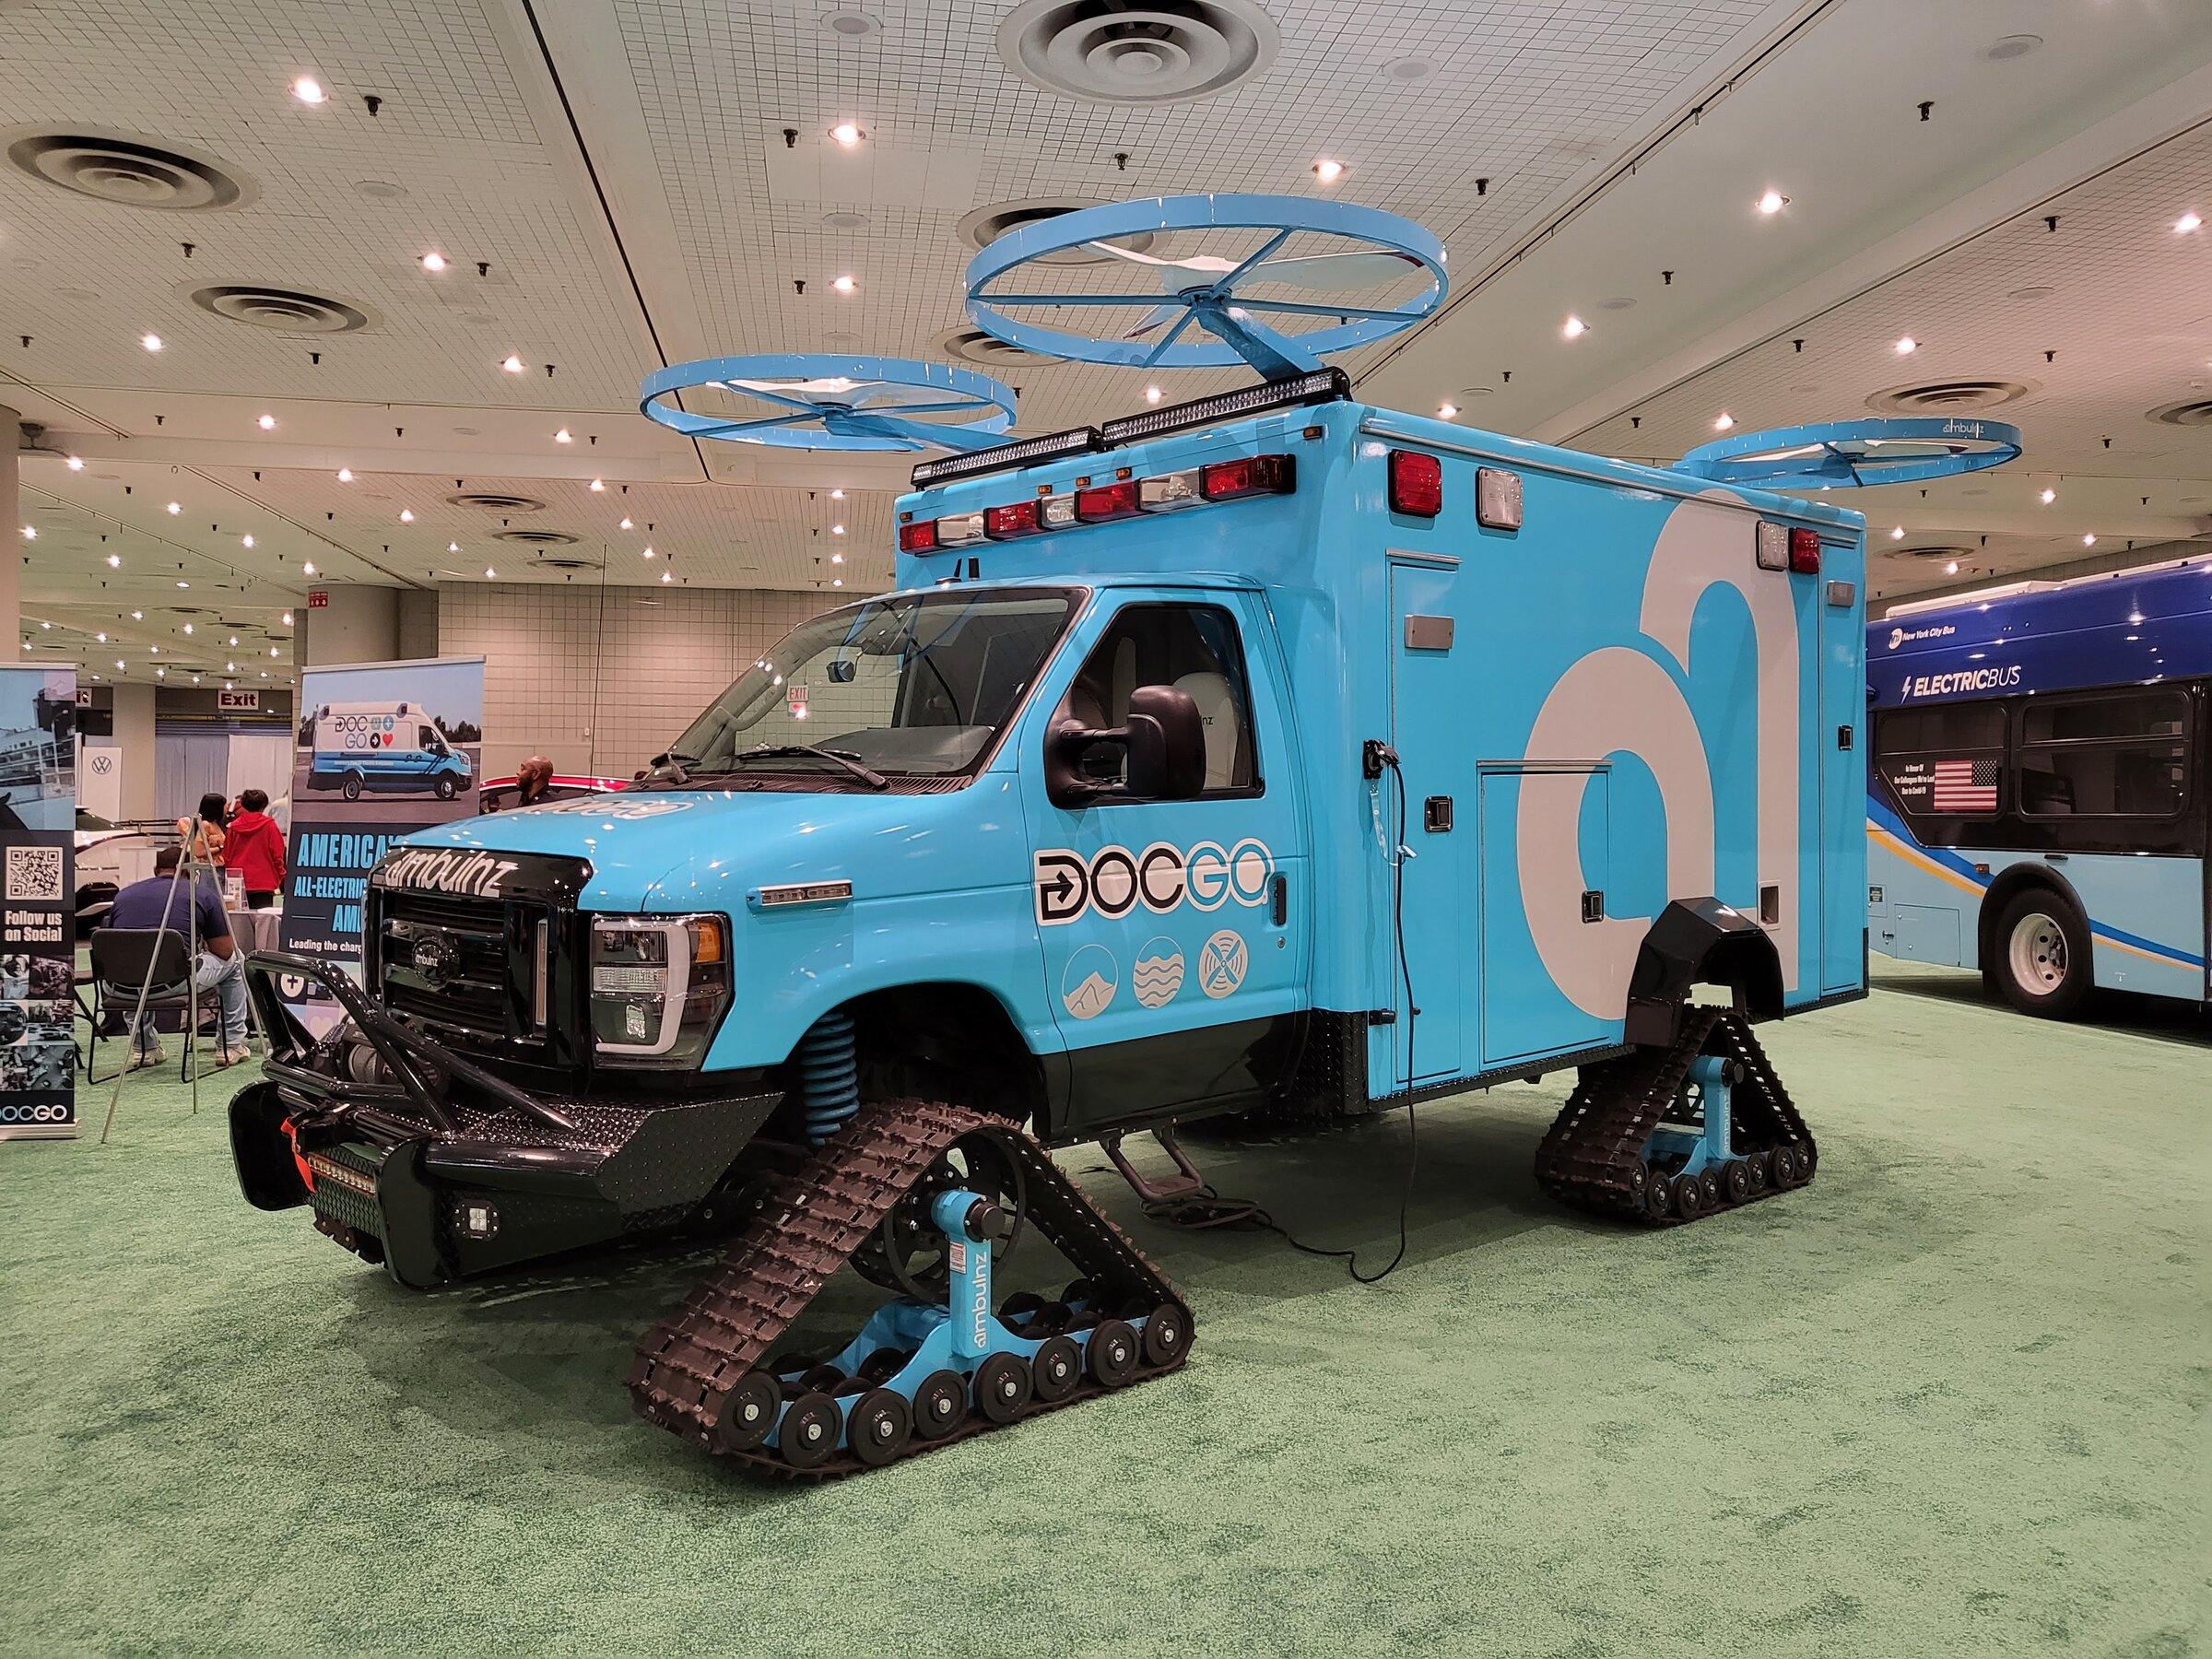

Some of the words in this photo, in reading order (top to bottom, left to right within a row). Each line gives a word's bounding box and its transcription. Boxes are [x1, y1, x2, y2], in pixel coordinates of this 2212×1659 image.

[1942, 422, 1984, 433] ambulz
[1902, 632, 1916, 641] New
[1917, 629, 1929, 639] York
[1930, 628, 1943, 638] City
[1943, 626, 1956, 635] Bus
[1913, 665, 2021, 697] ELECTRICBUS
[220, 693, 256, 706] Exit
[790, 687, 806, 700] EXIT
[345, 733, 367, 748] GO
[385, 849, 519, 898] ambulnz
[1038, 841, 1272, 923] DOCGO
[5, 910, 45, 925] Follow
[47, 912, 63, 925] us
[5, 928, 21, 942] on
[23, 926, 63, 942] Social
[288, 938, 322, 952] Leading
[324, 940, 338, 951] the
[0, 1104, 68, 1121] OCGO
[972, 1251, 988, 1348] ambulnz
